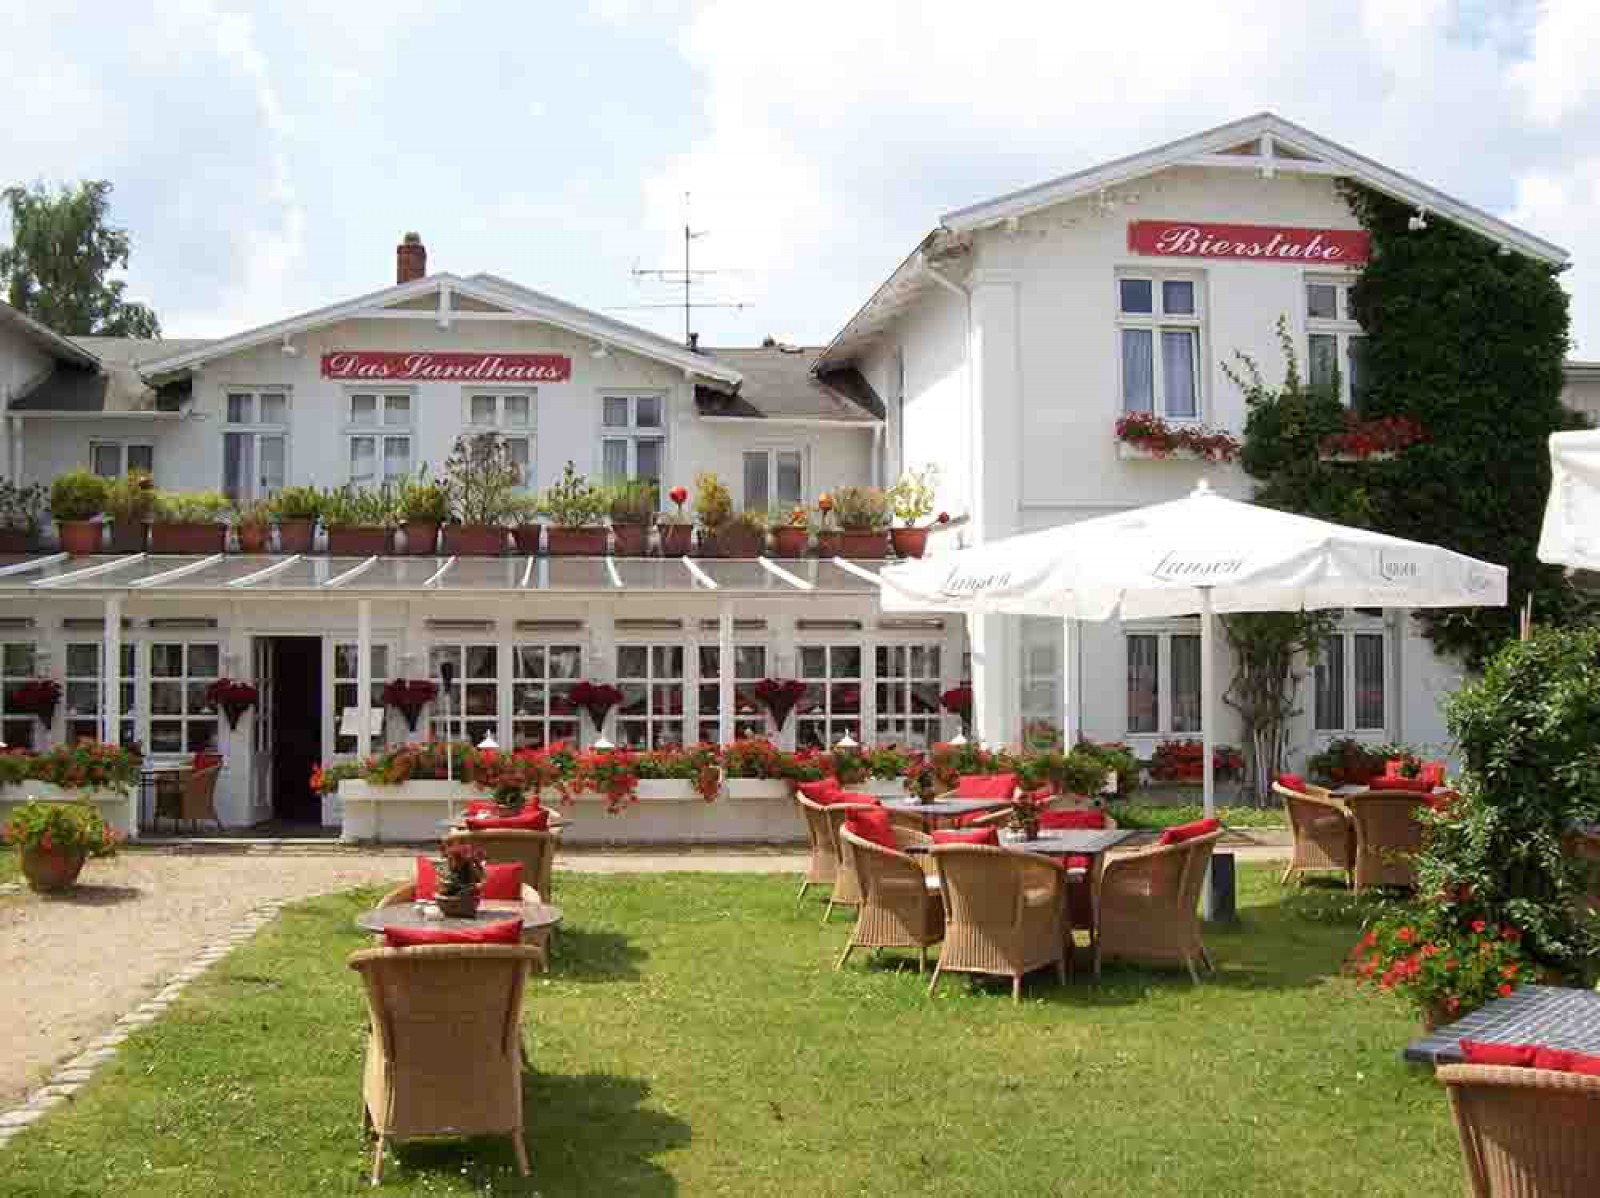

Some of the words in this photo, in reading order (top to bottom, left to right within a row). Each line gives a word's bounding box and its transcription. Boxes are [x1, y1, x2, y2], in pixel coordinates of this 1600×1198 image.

[1155, 226, 1345, 260] Bierstube
[330, 353, 390, 378] Das
[398, 353, 562, 379] Landhaus
